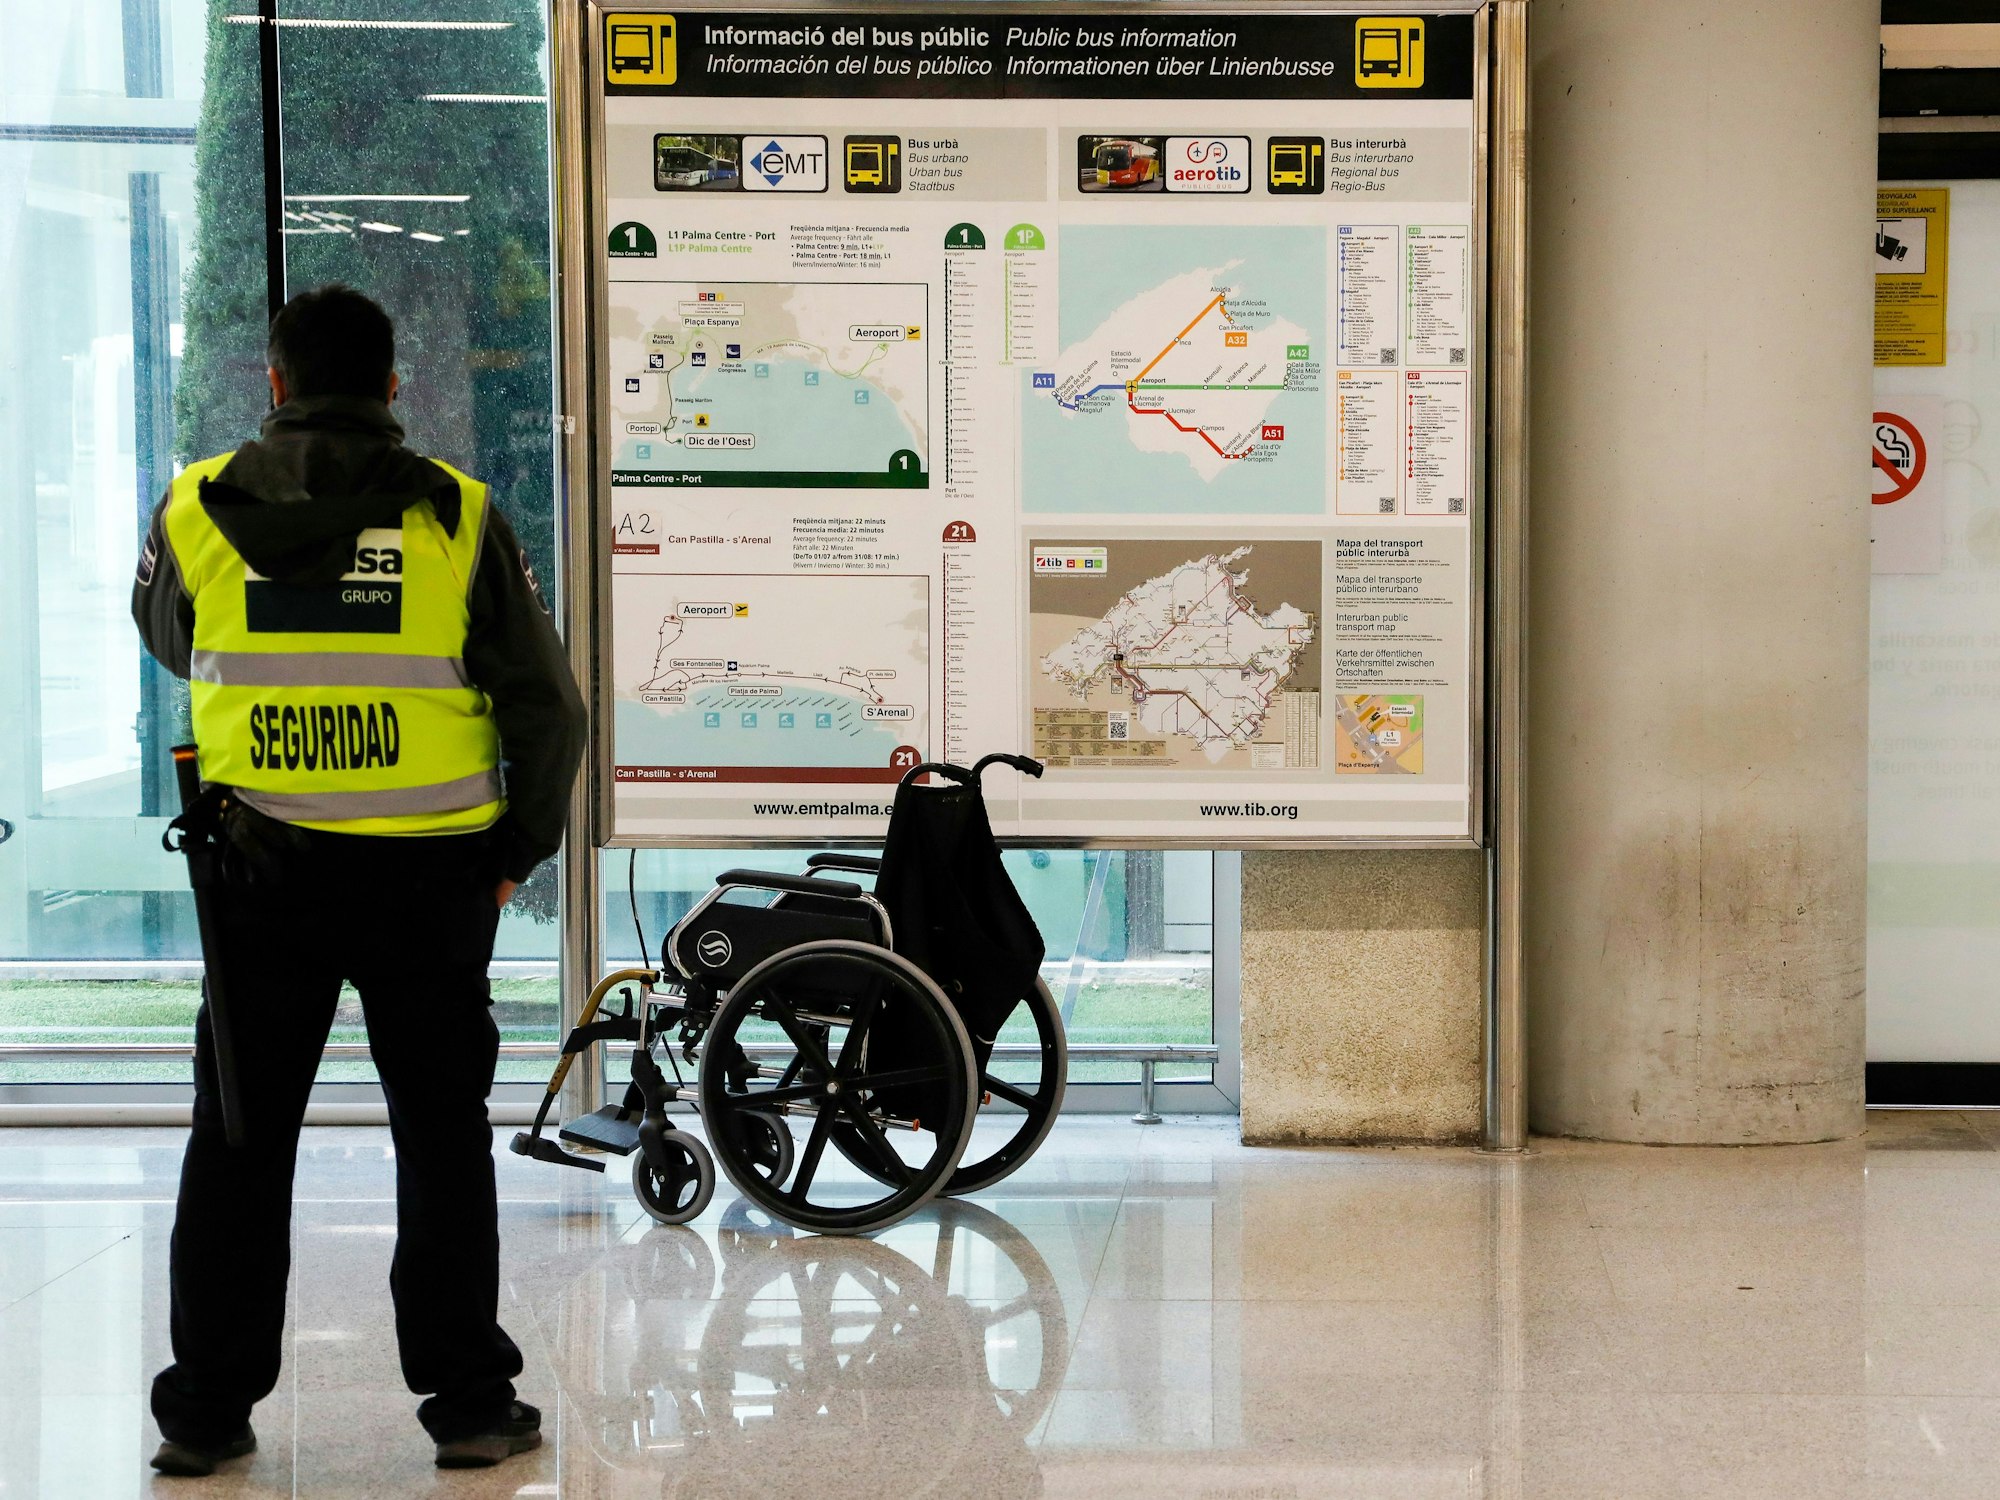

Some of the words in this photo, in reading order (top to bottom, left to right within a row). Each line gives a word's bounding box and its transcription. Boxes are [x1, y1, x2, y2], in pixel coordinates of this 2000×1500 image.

[706, 26, 824, 45] Informació
[832, 27, 864, 46] del
[873, 27, 913, 46] bus
[921, 27, 989, 50] públic
[1006, 28, 1070, 46] Public
[1076, 28, 1114, 46] bus
[1121, 28, 1236, 47] information
[707, 54, 828, 74] Información
[836, 56, 868, 74] del
[874, 56, 911, 74] bus
[917, 56, 992, 79] público
[1007, 56, 1149, 75] Informationen
[1156, 57, 1204, 75] über
[1210, 57, 1334, 76] Linienbusse
[909, 139, 929, 148] Bus
[934, 139, 958, 148] urbà
[1331, 139, 1352, 148] Bus
[1356, 139, 1406, 148] interurbà
[909, 153, 928, 162] Bus
[932, 154, 968, 163] urbano
[1331, 153, 1351, 162] Bus
[1354, 153, 1413, 162] interurbano
[910, 168, 940, 176] Urban
[944, 168, 962, 177] bus
[1174, 167, 1240, 180] aerotib
[1331, 168, 1377, 179] Regional
[1380, 168, 1399, 176] bus
[909, 181, 954, 191] Stadtbus
[1331, 181, 1385, 193] Regio-Bus
[624, 227, 636, 247] 1
[683, 231, 711, 239] Palma
[715, 232, 746, 240] Centre
[756, 232, 775, 240] Port
[960, 229, 968, 244] 1
[1017, 230, 1034, 244] 1P
[669, 244, 685, 252] L1P
[689, 244, 717, 252] Palma
[721, 244, 752, 252] Centre
[856, 328, 898, 338] Aeroport
[630, 424, 658, 432] Portopí
[688, 437, 706, 445] Dic
[708, 437, 720, 446] de
[722, 437, 751, 446] l'Oest
[899, 456, 907, 469] 1
[612, 474, 640, 482] Palma
[644, 474, 674, 482] Centre
[952, 525, 967, 537] 21
[733, 536, 771, 544] s'Arenal
[1337, 540, 1360, 549] Mapa
[1381, 540, 1422, 549] transport
[1337, 548, 1364, 558] públic
[1368, 548, 1409, 556] interurbà
[353, 548, 402, 574] sa
[1047, 558, 1062, 566] tib
[1337, 575, 1360, 585] Mapa
[1379, 576, 1422, 585] transporte
[1336, 584, 1366, 594] público
[342, 590, 391, 603] GRUPO
[683, 606, 727, 615] Aeroport
[1337, 613, 1380, 621] Interurban
[1383, 614, 1408, 623] public
[1336, 624, 1374, 632] transport
[1336, 649, 1358, 658] Karte
[1336, 659, 1394, 667] Verkehrsmittel
[1397, 659, 1434, 667] zwischen
[1336, 668, 1383, 676] Ortschaften
[867, 708, 908, 717] S'Arenal
[250, 702, 399, 770] SEGURIDAD
[897, 752, 914, 765] 21
[679, 770, 716, 778] s'Arenal
[754, 802, 893, 818] www.emtpalma.e
[1200, 803, 1297, 819] www.tib.org
